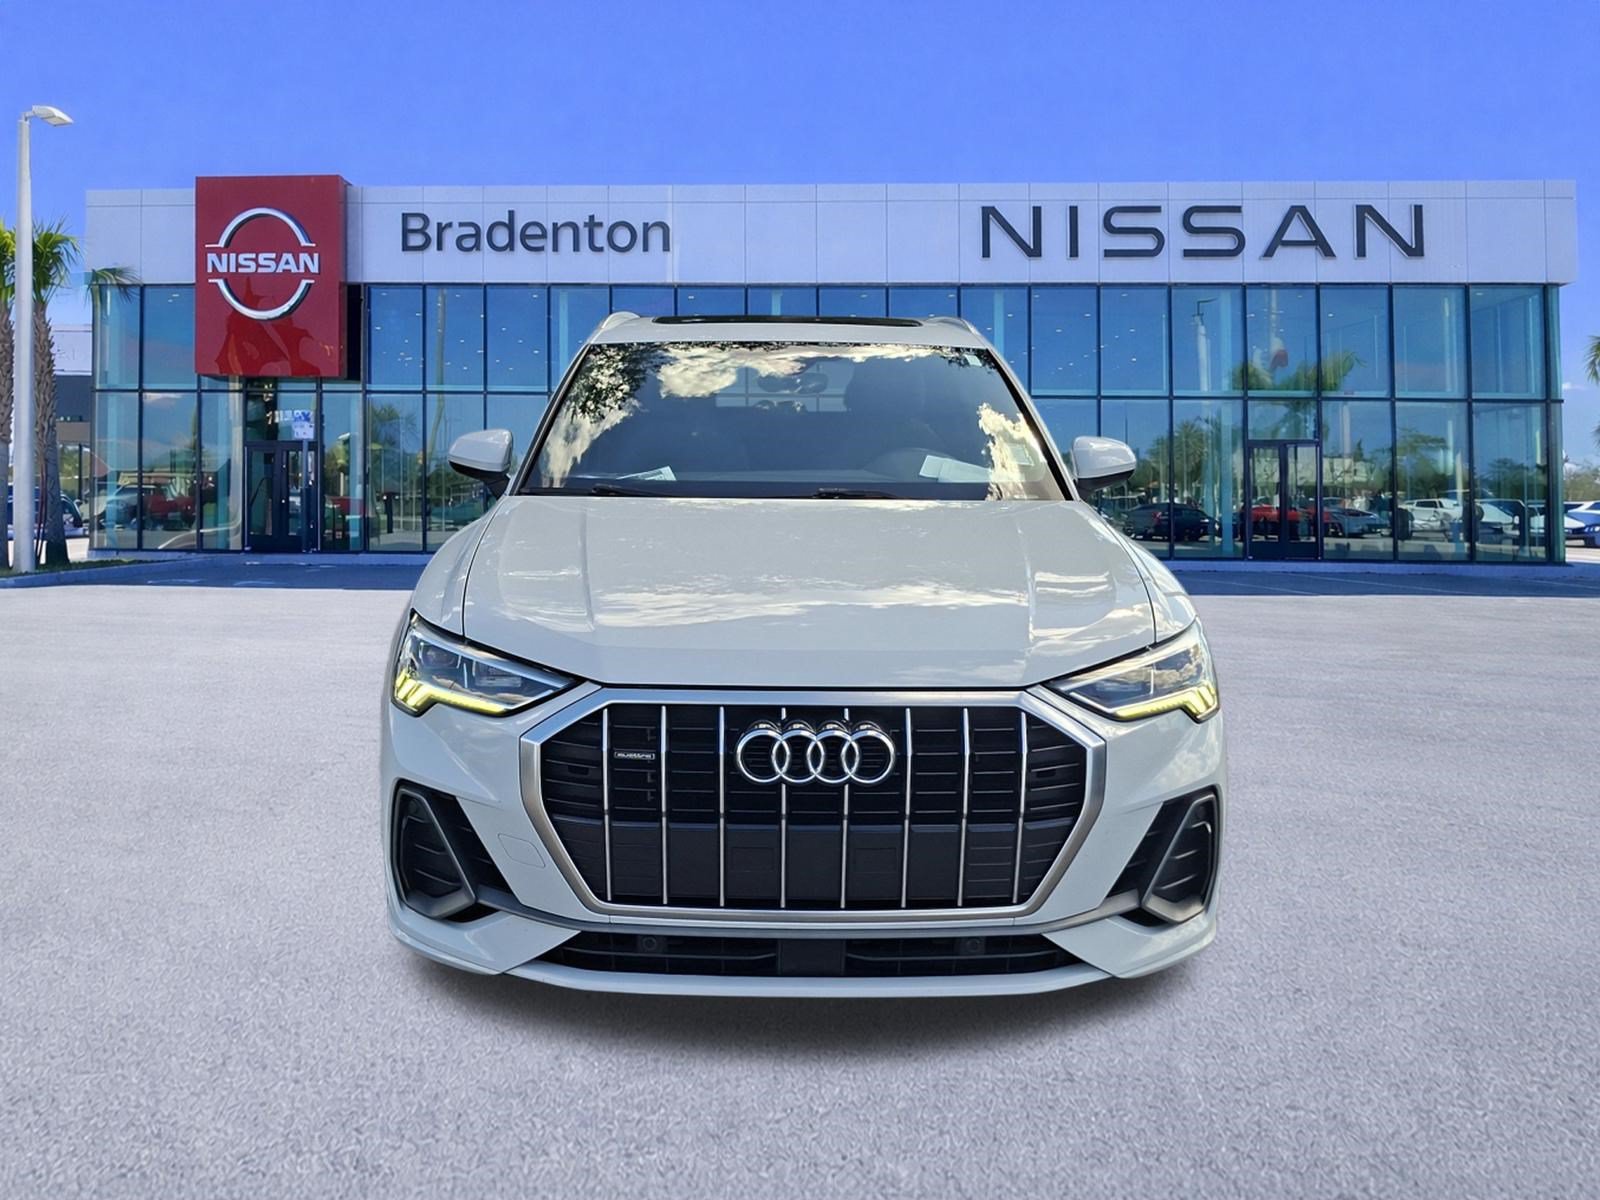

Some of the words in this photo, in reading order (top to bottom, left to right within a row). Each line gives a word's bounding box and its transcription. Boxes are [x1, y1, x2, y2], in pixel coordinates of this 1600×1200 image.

[401, 210, 671, 253] Bradenton
[981, 204, 1425, 259] NISSAN
[206, 252, 319, 273] NISSAN
